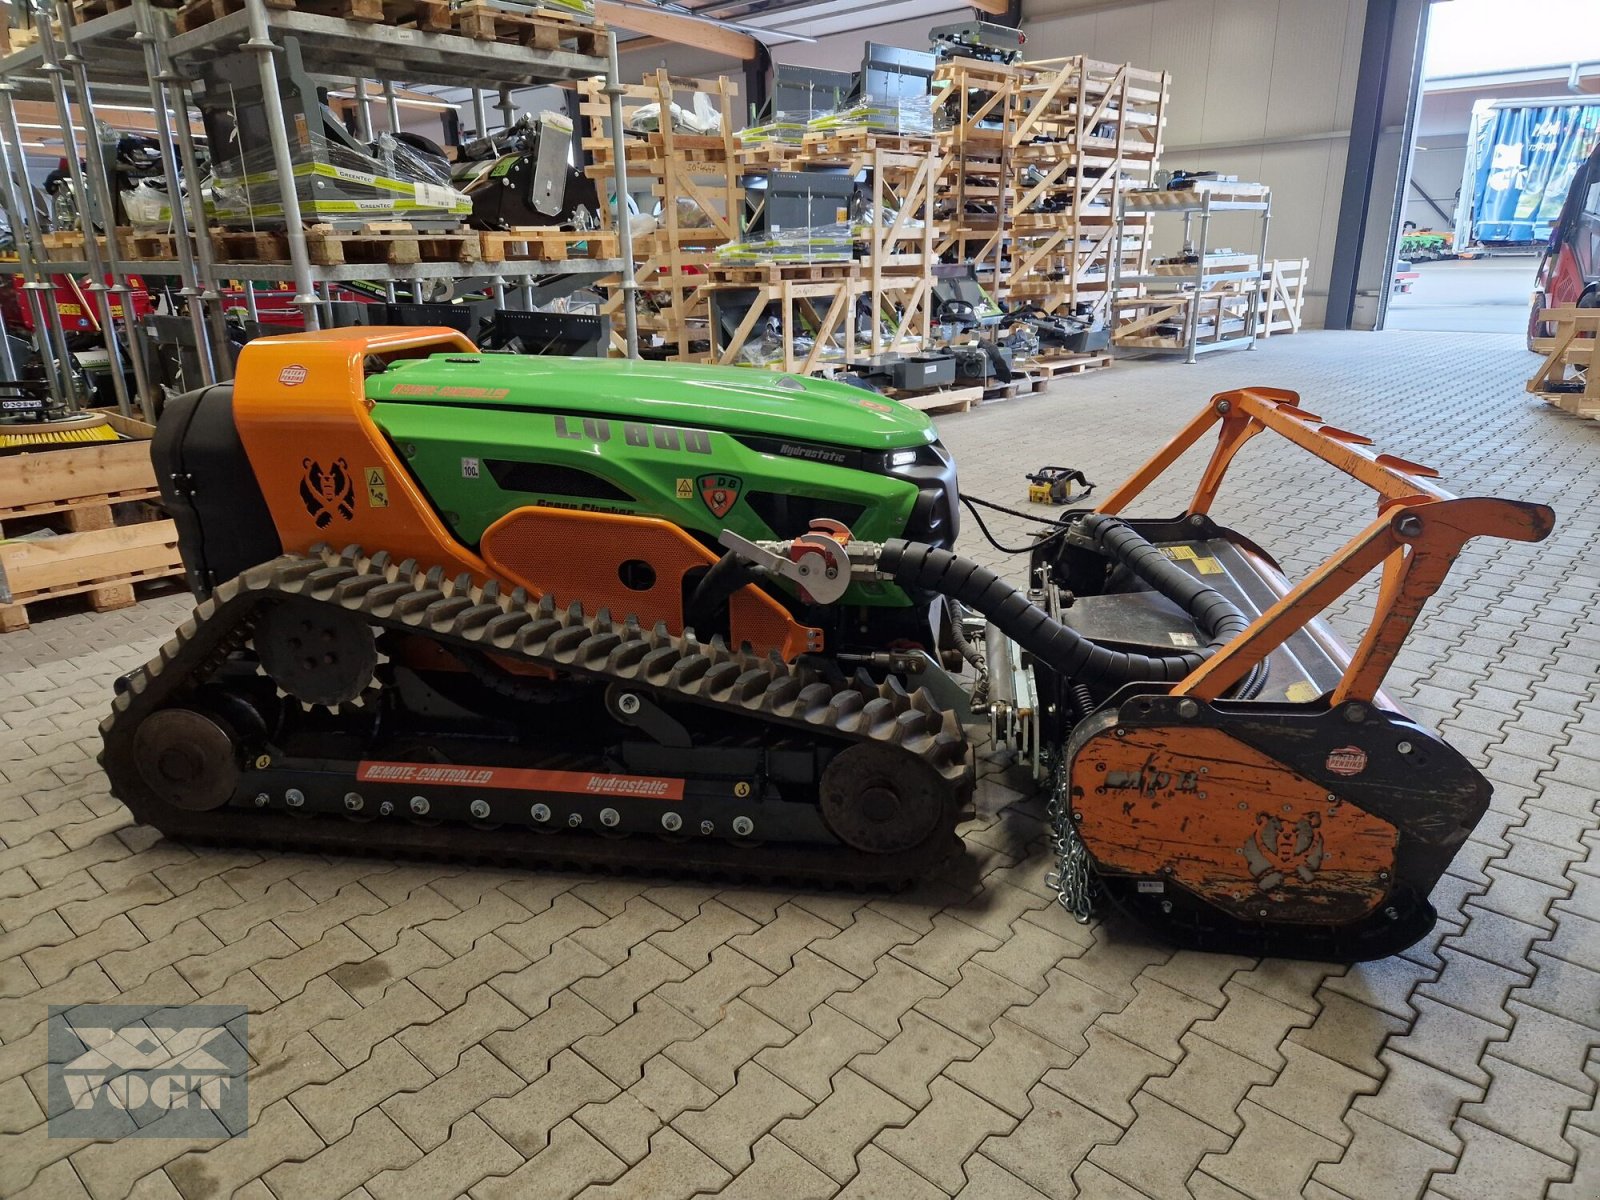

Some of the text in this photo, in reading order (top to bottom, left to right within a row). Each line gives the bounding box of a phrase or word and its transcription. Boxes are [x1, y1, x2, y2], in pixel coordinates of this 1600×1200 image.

[623, 422, 713, 455] 800
[780, 444, 846, 462] Hydrostatic
[365, 765, 494, 784] REMOTE-CONTROLLED
[586, 776, 669, 795] Hydrostatic
